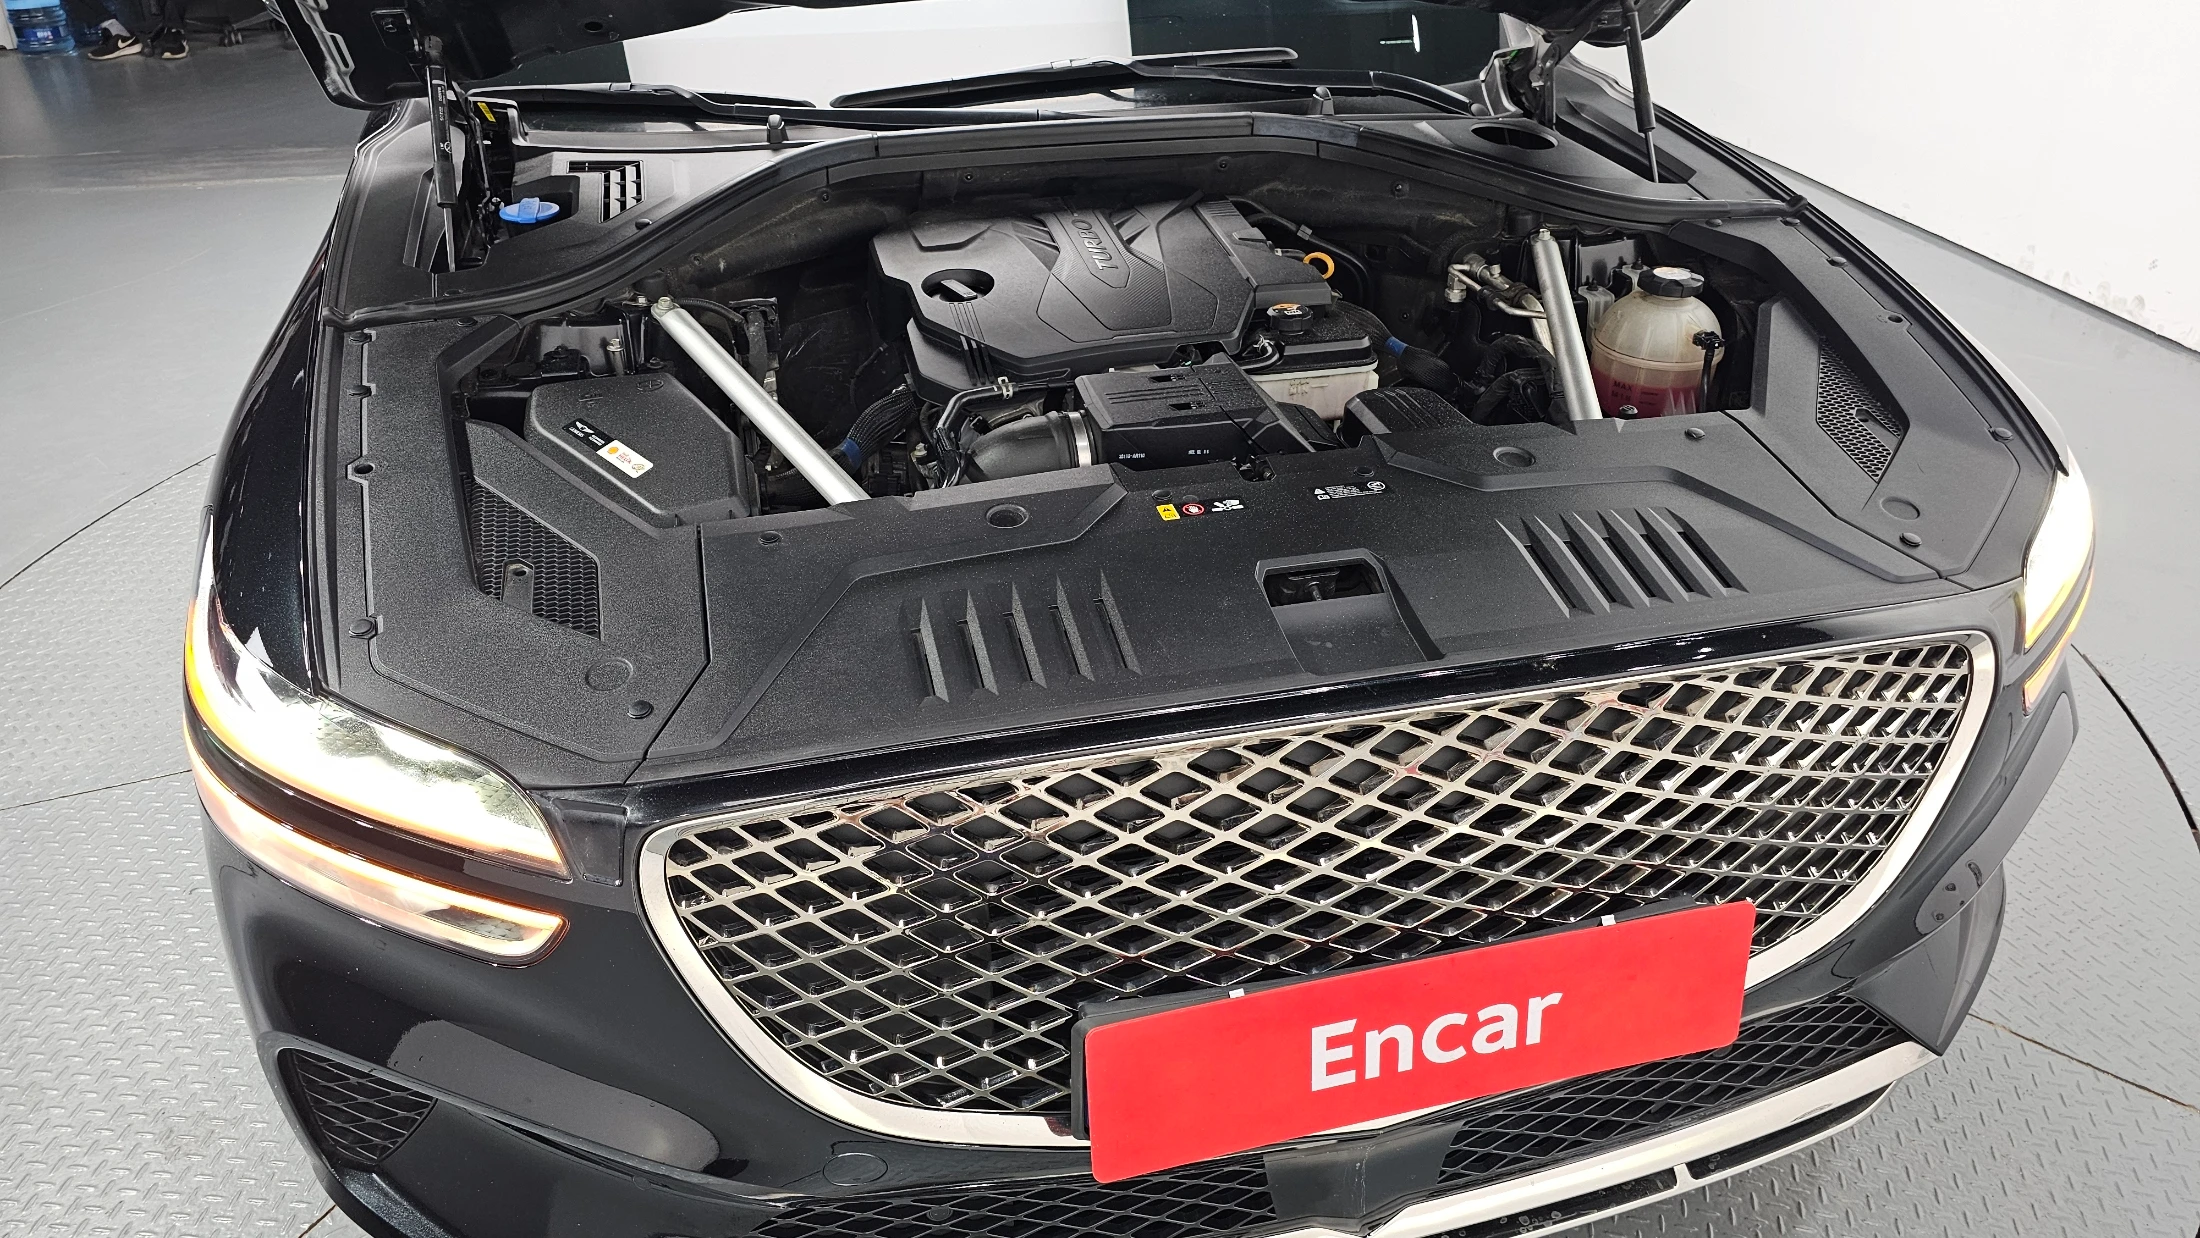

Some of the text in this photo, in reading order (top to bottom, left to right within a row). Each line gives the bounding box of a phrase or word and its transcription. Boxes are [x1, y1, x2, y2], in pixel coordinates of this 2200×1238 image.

[1071, 218, 1119, 271] TURBO
[1611, 390, 1632, 402] MIN
[1613, 380, 1633, 392] MAX
[1311, 992, 1563, 1092] Encar
